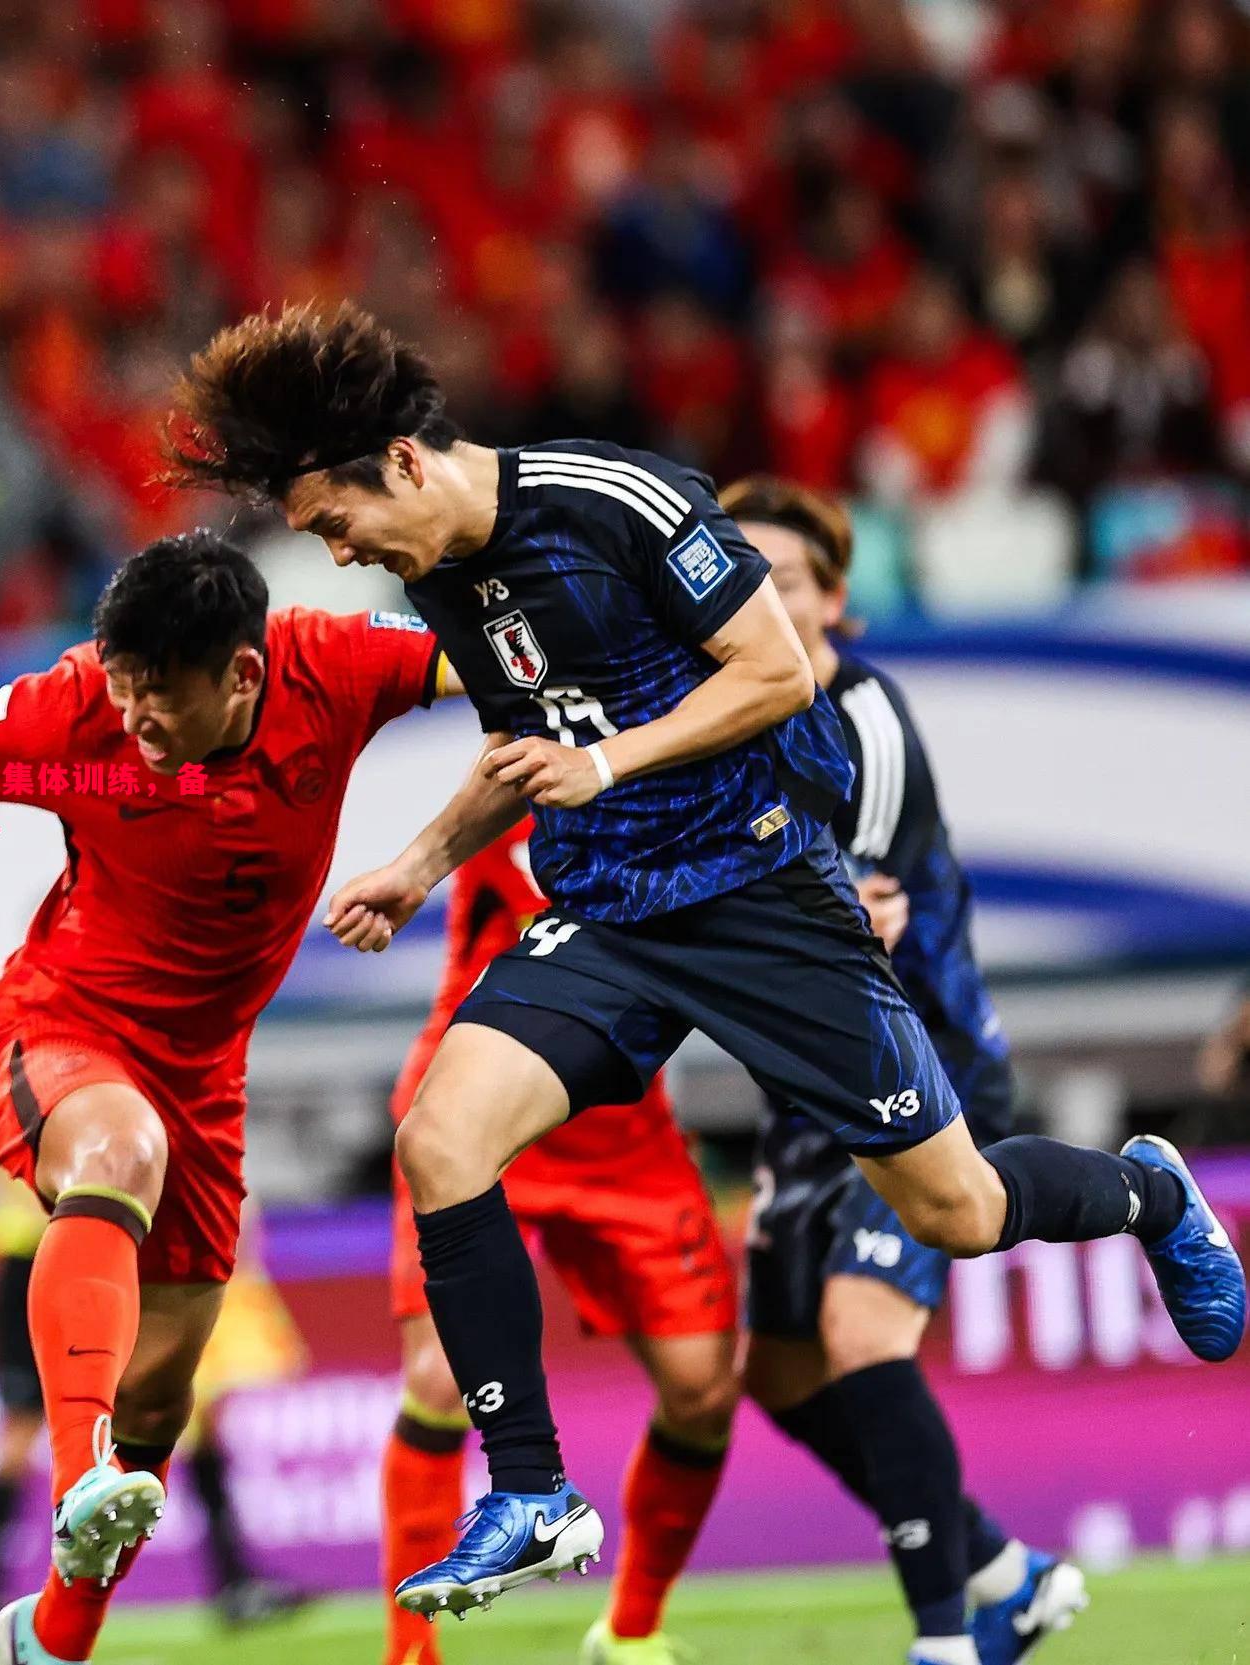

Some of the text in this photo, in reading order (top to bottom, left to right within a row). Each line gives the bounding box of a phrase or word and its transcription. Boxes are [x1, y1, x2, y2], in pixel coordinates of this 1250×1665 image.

[225, 853, 267, 914] 5
[519, 917, 581, 956] 4
[869, 1089, 920, 1124] Y-3
